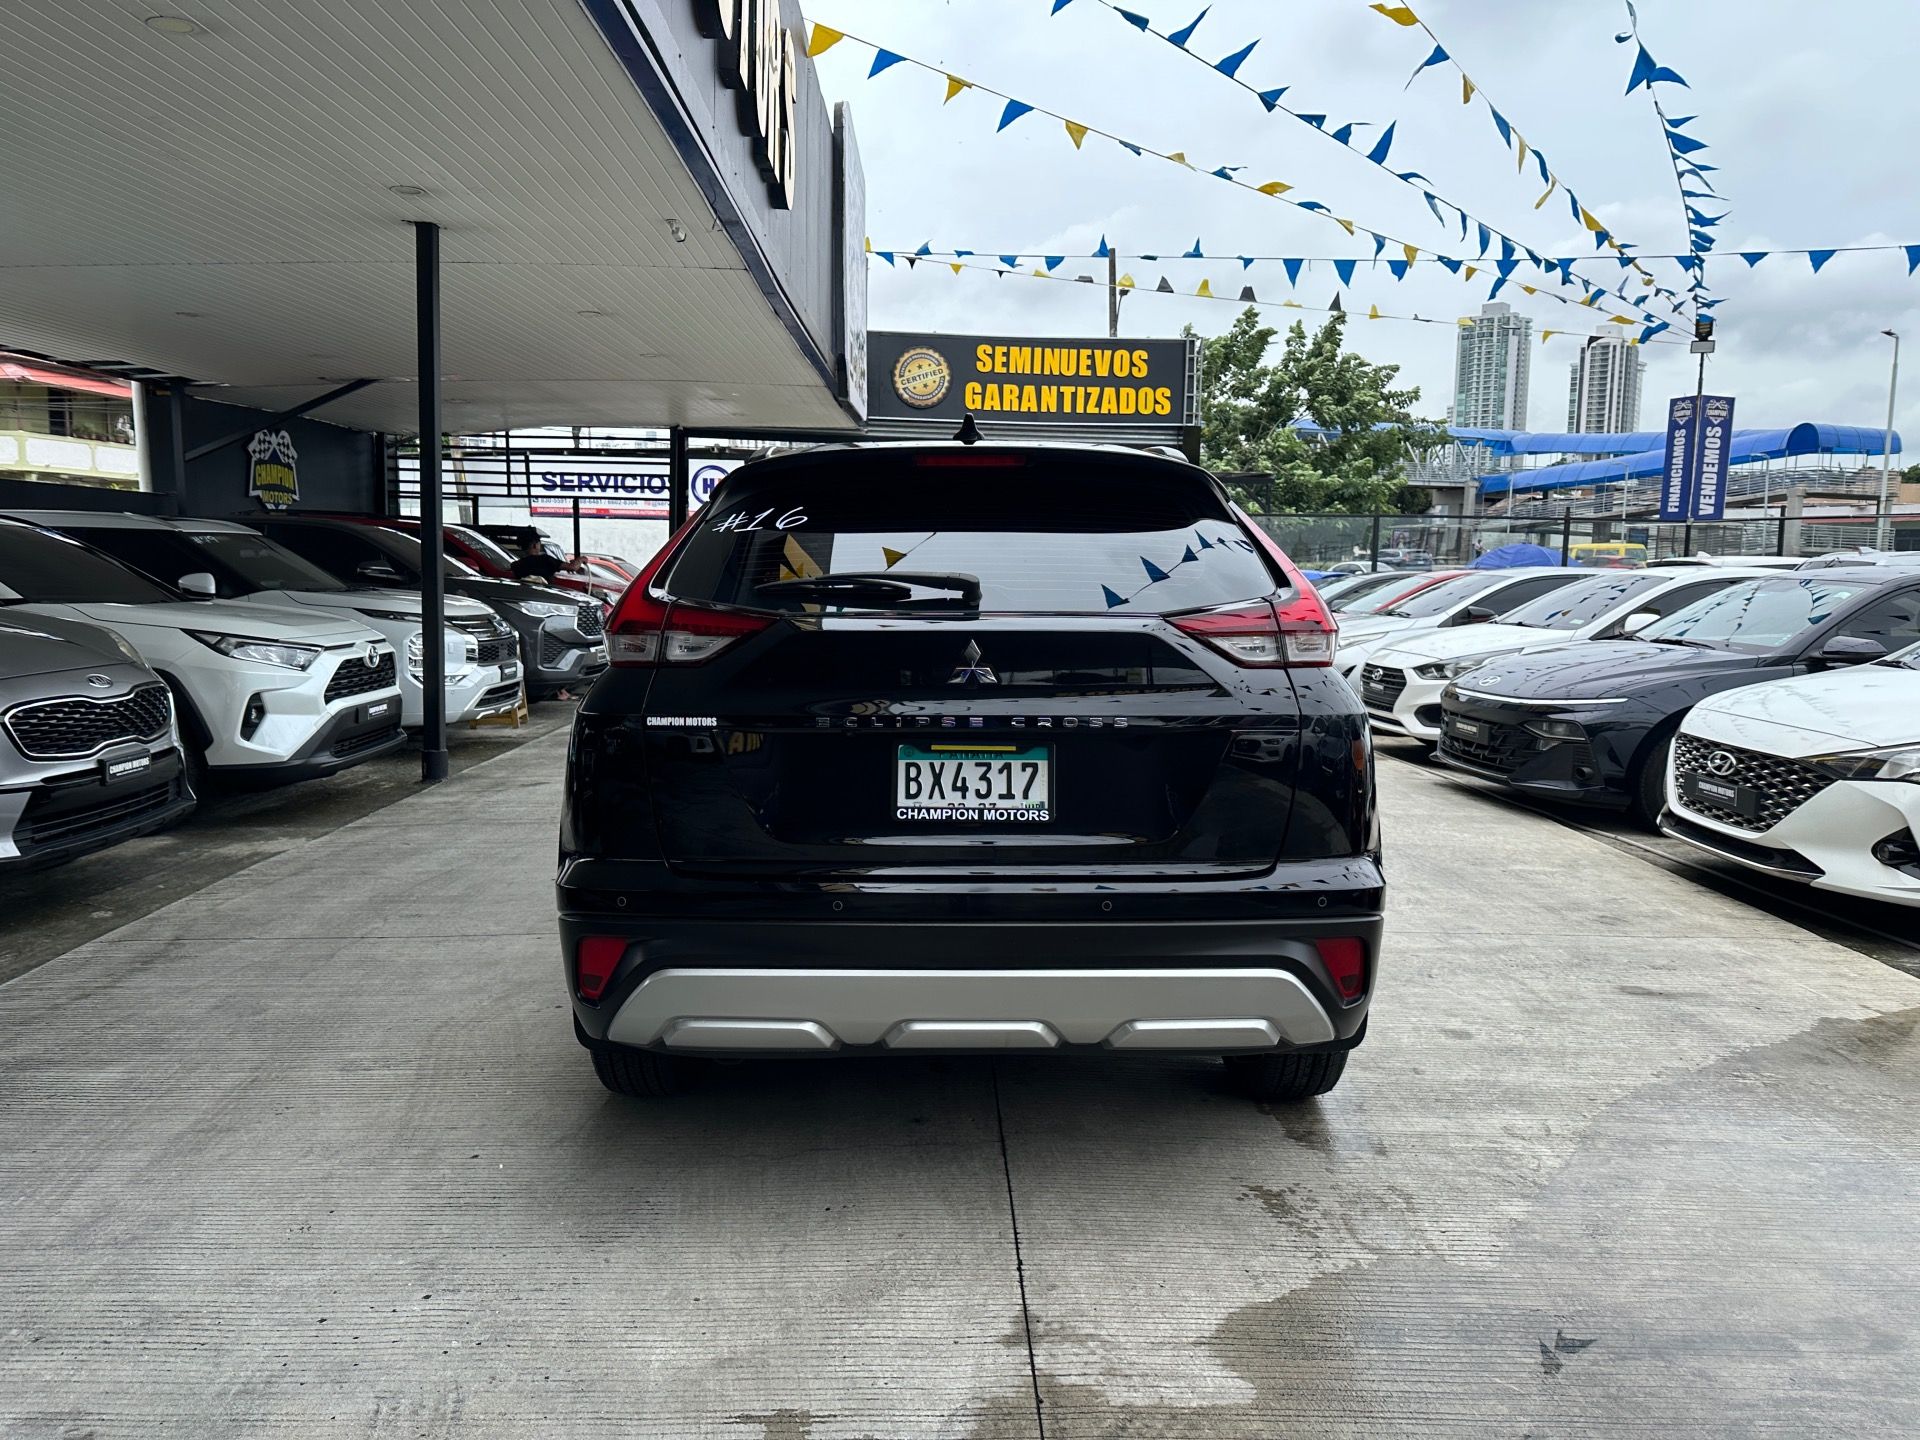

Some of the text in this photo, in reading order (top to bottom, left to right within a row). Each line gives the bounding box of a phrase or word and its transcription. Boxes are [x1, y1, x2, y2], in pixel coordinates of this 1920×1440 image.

[975, 344, 1149, 379] SEMINUEVOS
[900, 368, 944, 386] CERTIFIED
[964, 381, 1172, 416] GARANTIZADOS
[255, 463, 294, 490] CHAMPION
[541, 471, 670, 495] SERVICIO
[1667, 428, 1687, 513] FINANCIAMOS
[1698, 426, 1722, 516] VENDEMOS
[262, 490, 293, 505] MOTORS
[646, 716, 717, 727] CHAMPION MOTORS
[816, 716, 1128, 728] ECLIPSE CROSS
[904, 761, 1040, 800] BX4317
[896, 808, 1050, 821] CHAMPION MOTORS
